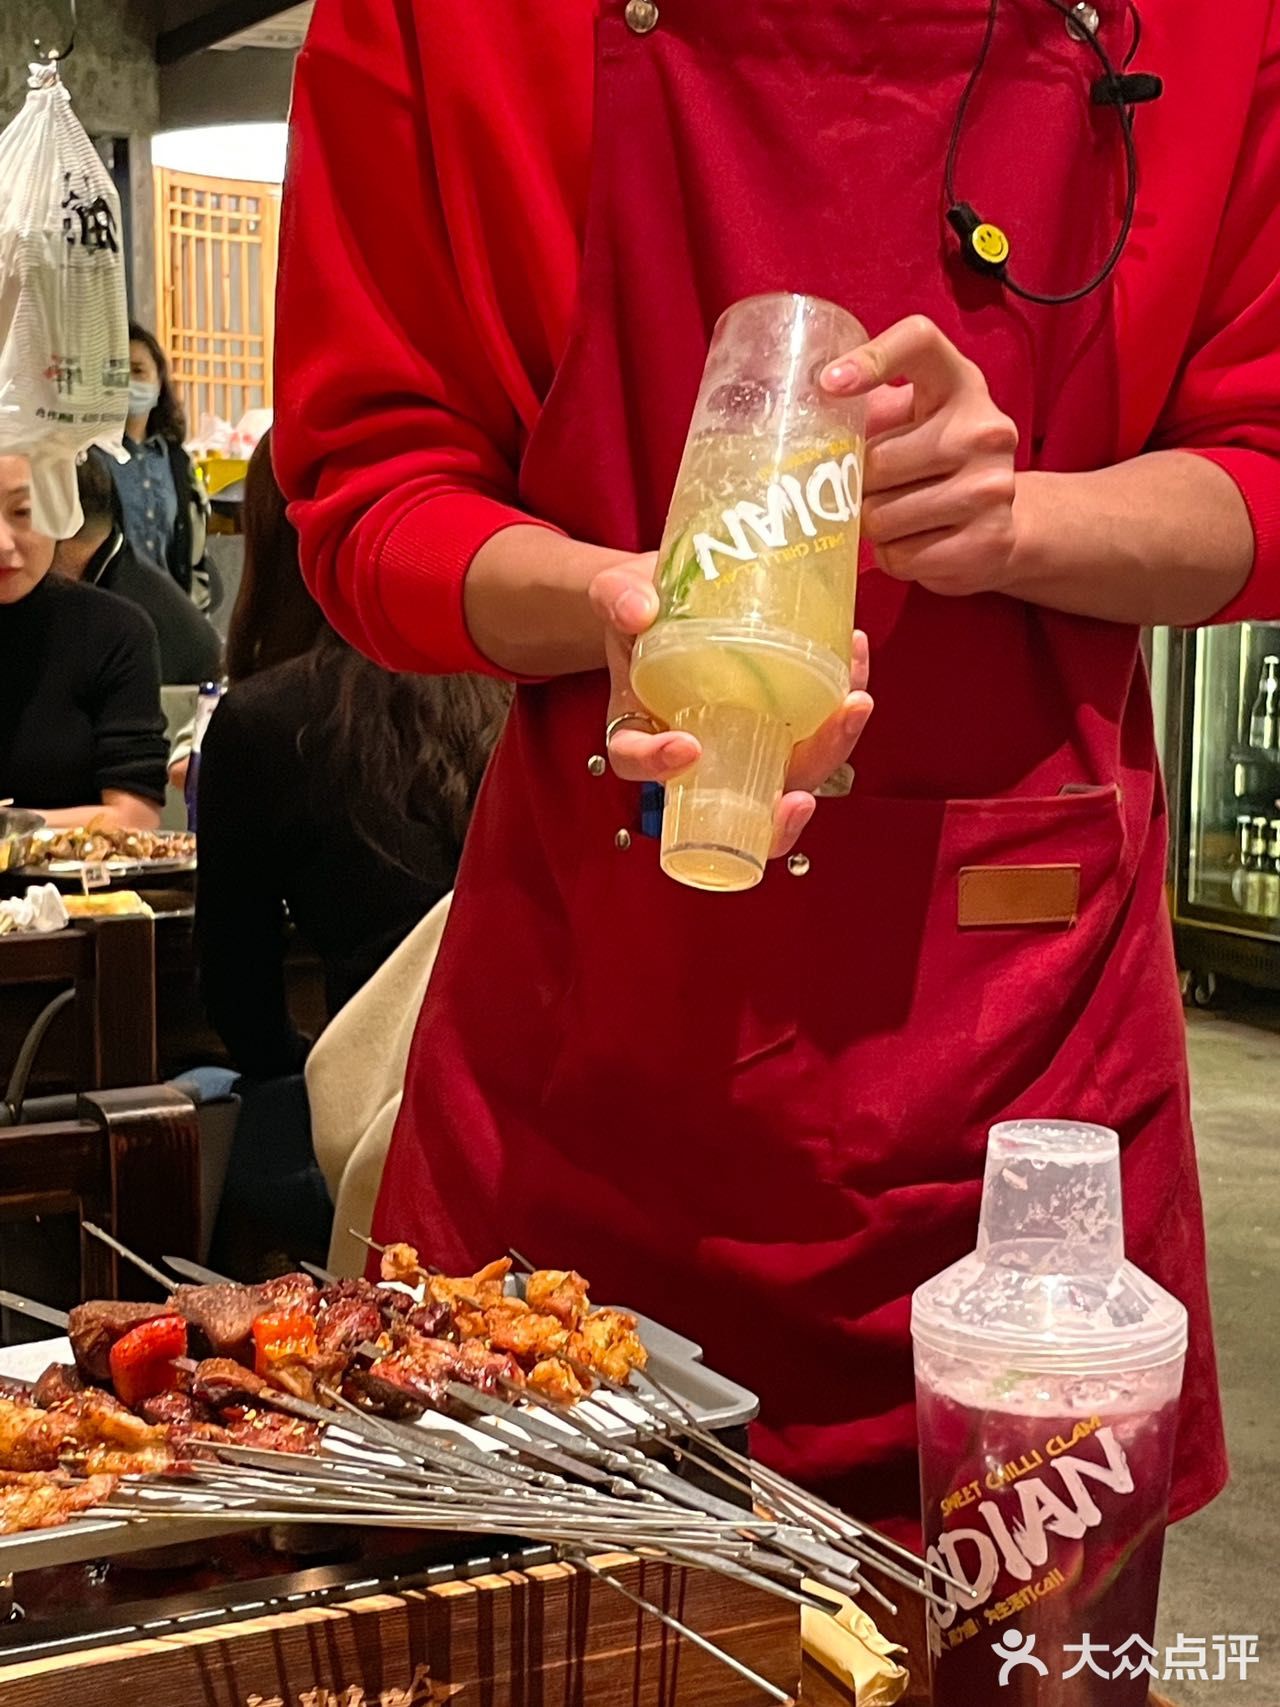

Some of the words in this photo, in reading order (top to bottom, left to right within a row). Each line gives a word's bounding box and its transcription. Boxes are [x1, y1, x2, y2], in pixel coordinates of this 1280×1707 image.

[940, 1479, 983, 1517] SWEET
[985, 1449, 1044, 1491] CHILLI
[1045, 1414, 1103, 1457] CLAM
